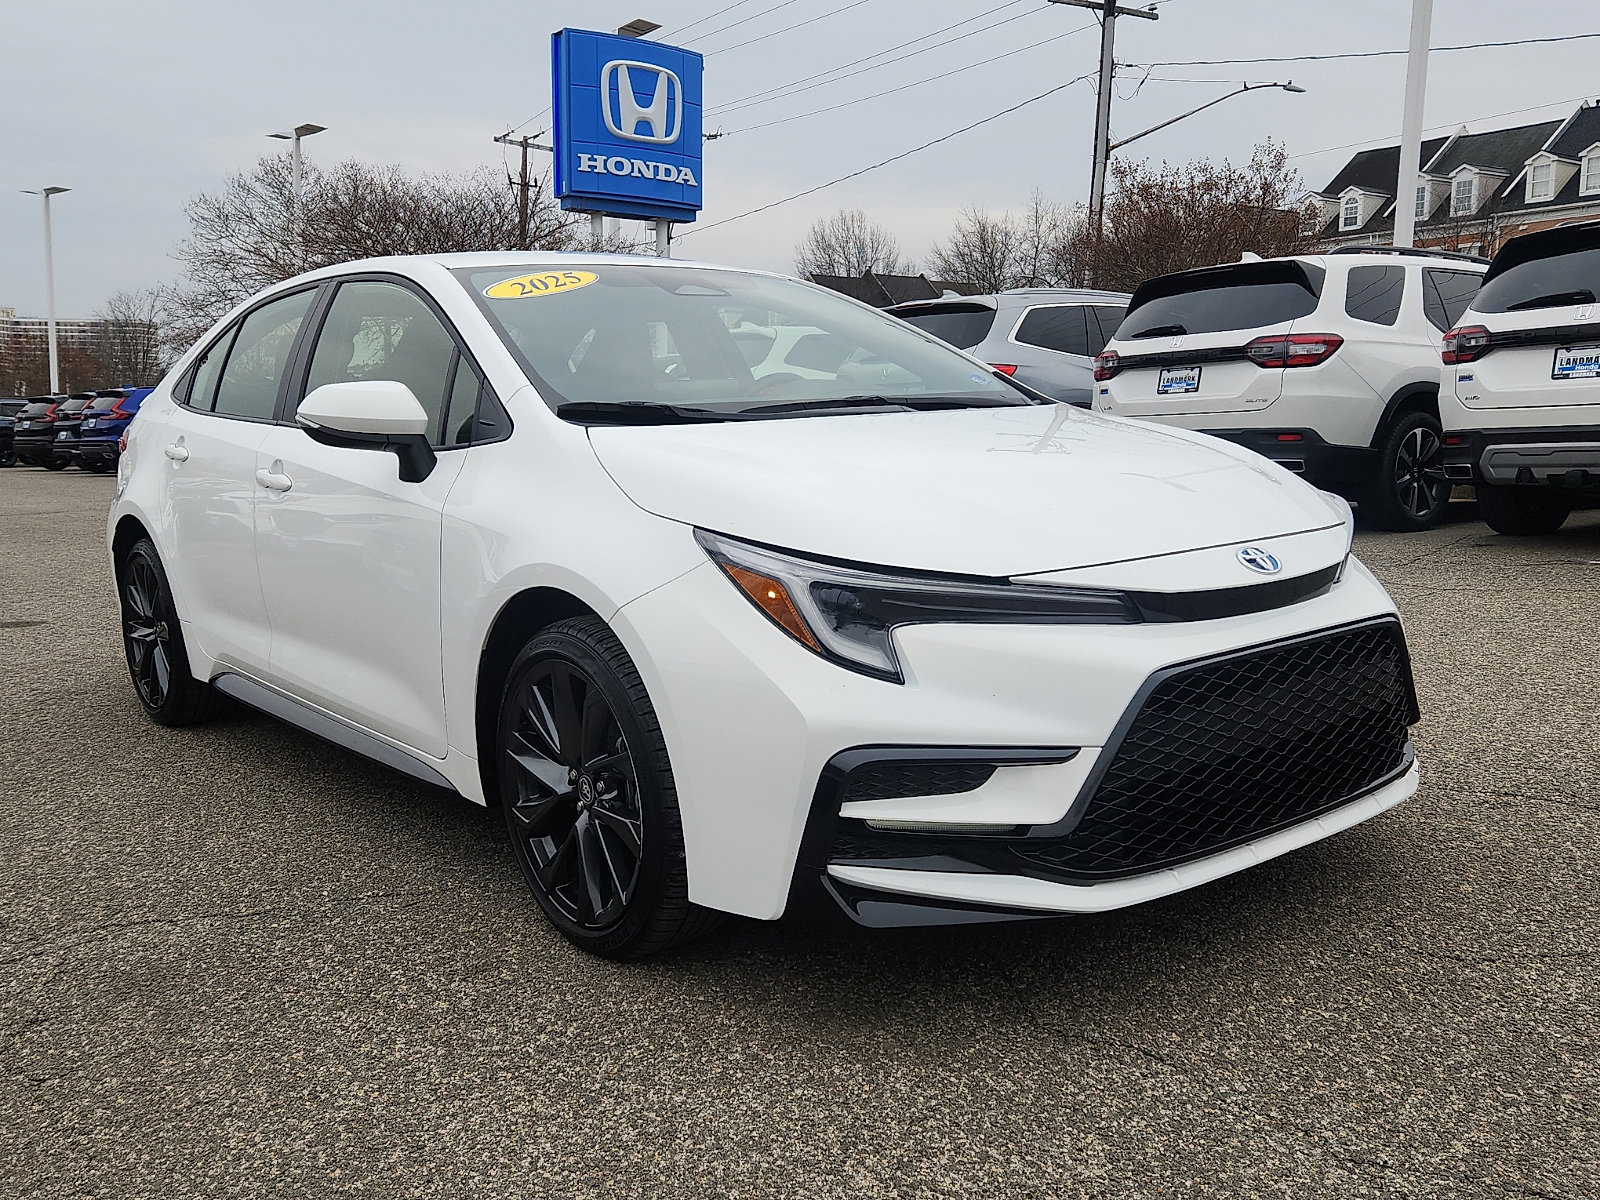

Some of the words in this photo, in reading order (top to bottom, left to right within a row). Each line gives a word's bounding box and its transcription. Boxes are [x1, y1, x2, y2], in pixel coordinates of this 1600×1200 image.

[577, 153, 698, 187] HONDA
[510, 271, 582, 296] 2025
[1559, 355, 1600, 367] LANDMA
[1575, 363, 1599, 371] Honda
[1162, 375, 1196, 385] LANDMARK
